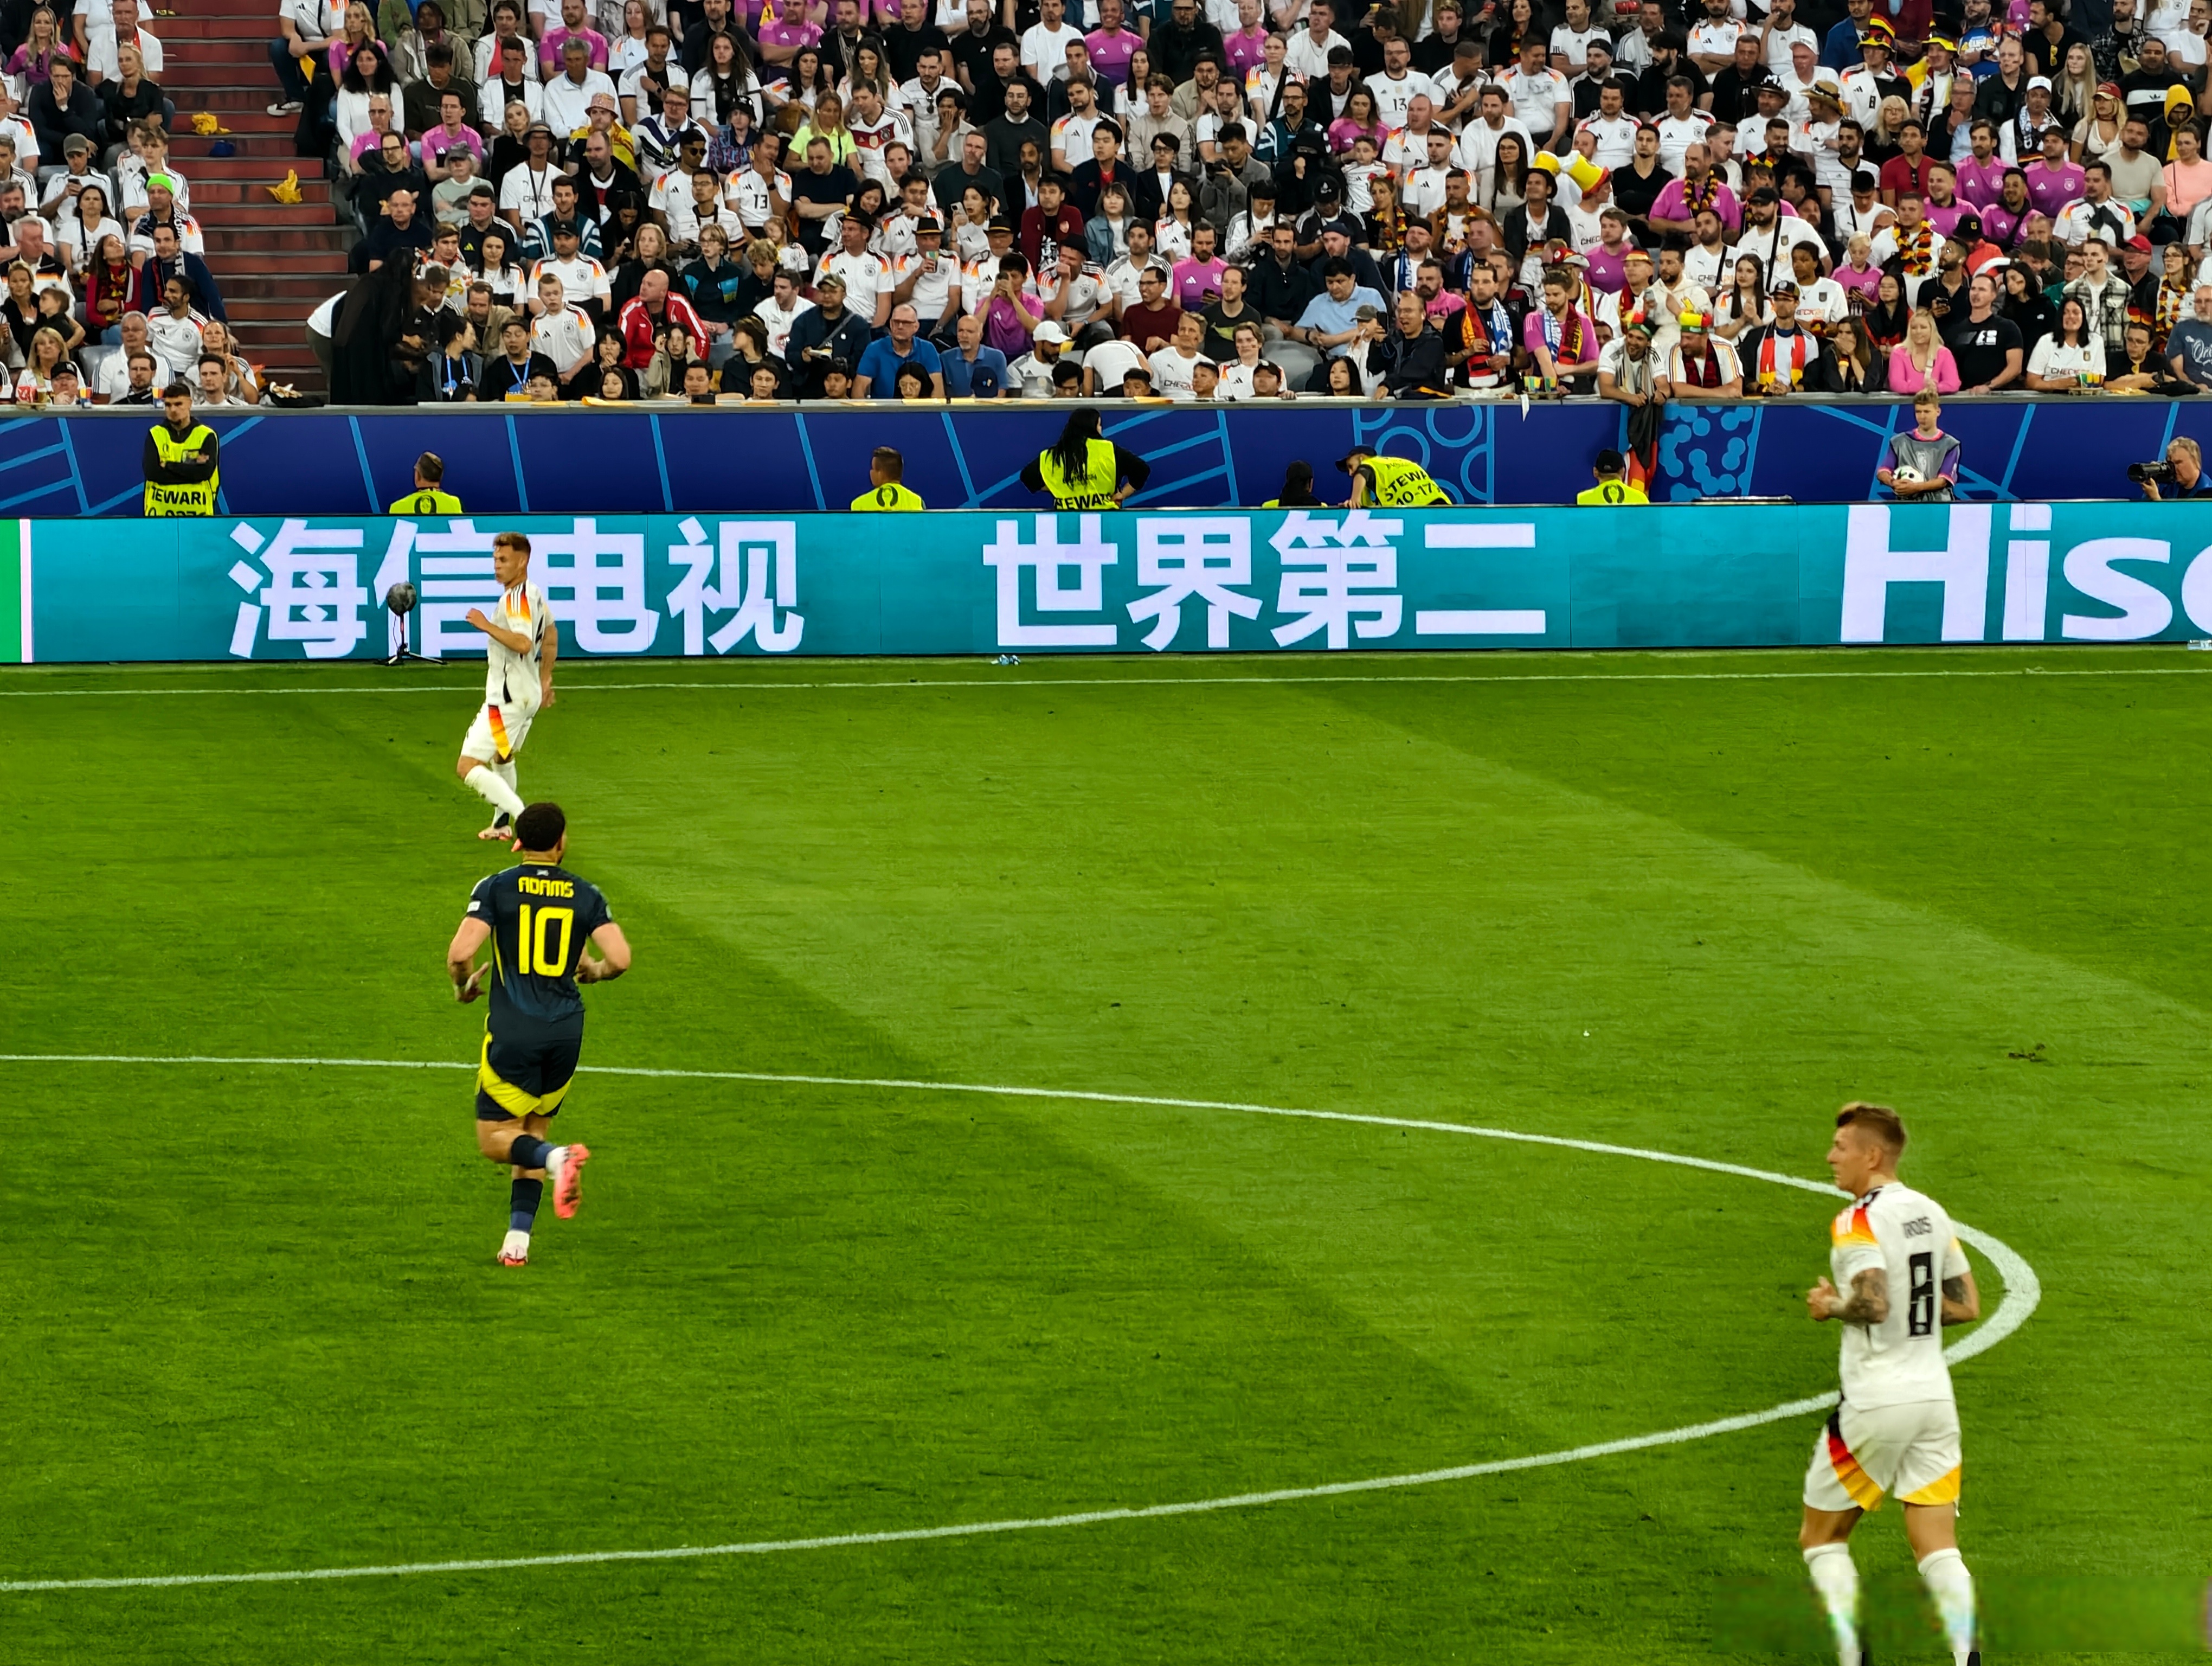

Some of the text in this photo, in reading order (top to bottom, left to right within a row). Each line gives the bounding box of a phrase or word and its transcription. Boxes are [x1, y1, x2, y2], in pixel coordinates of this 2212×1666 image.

[1393, 98, 1407, 111] 13
[753, 194, 768, 209] 13
[151, 486, 207, 505] TEWAR
[228, 510, 1546, 659] 海信电视 世界第二
[1840, 504, 2212, 642] His
[518, 876, 574, 898] ADAMS
[518, 903, 574, 977] 10
[1908, 1252, 1933, 1336] 8
